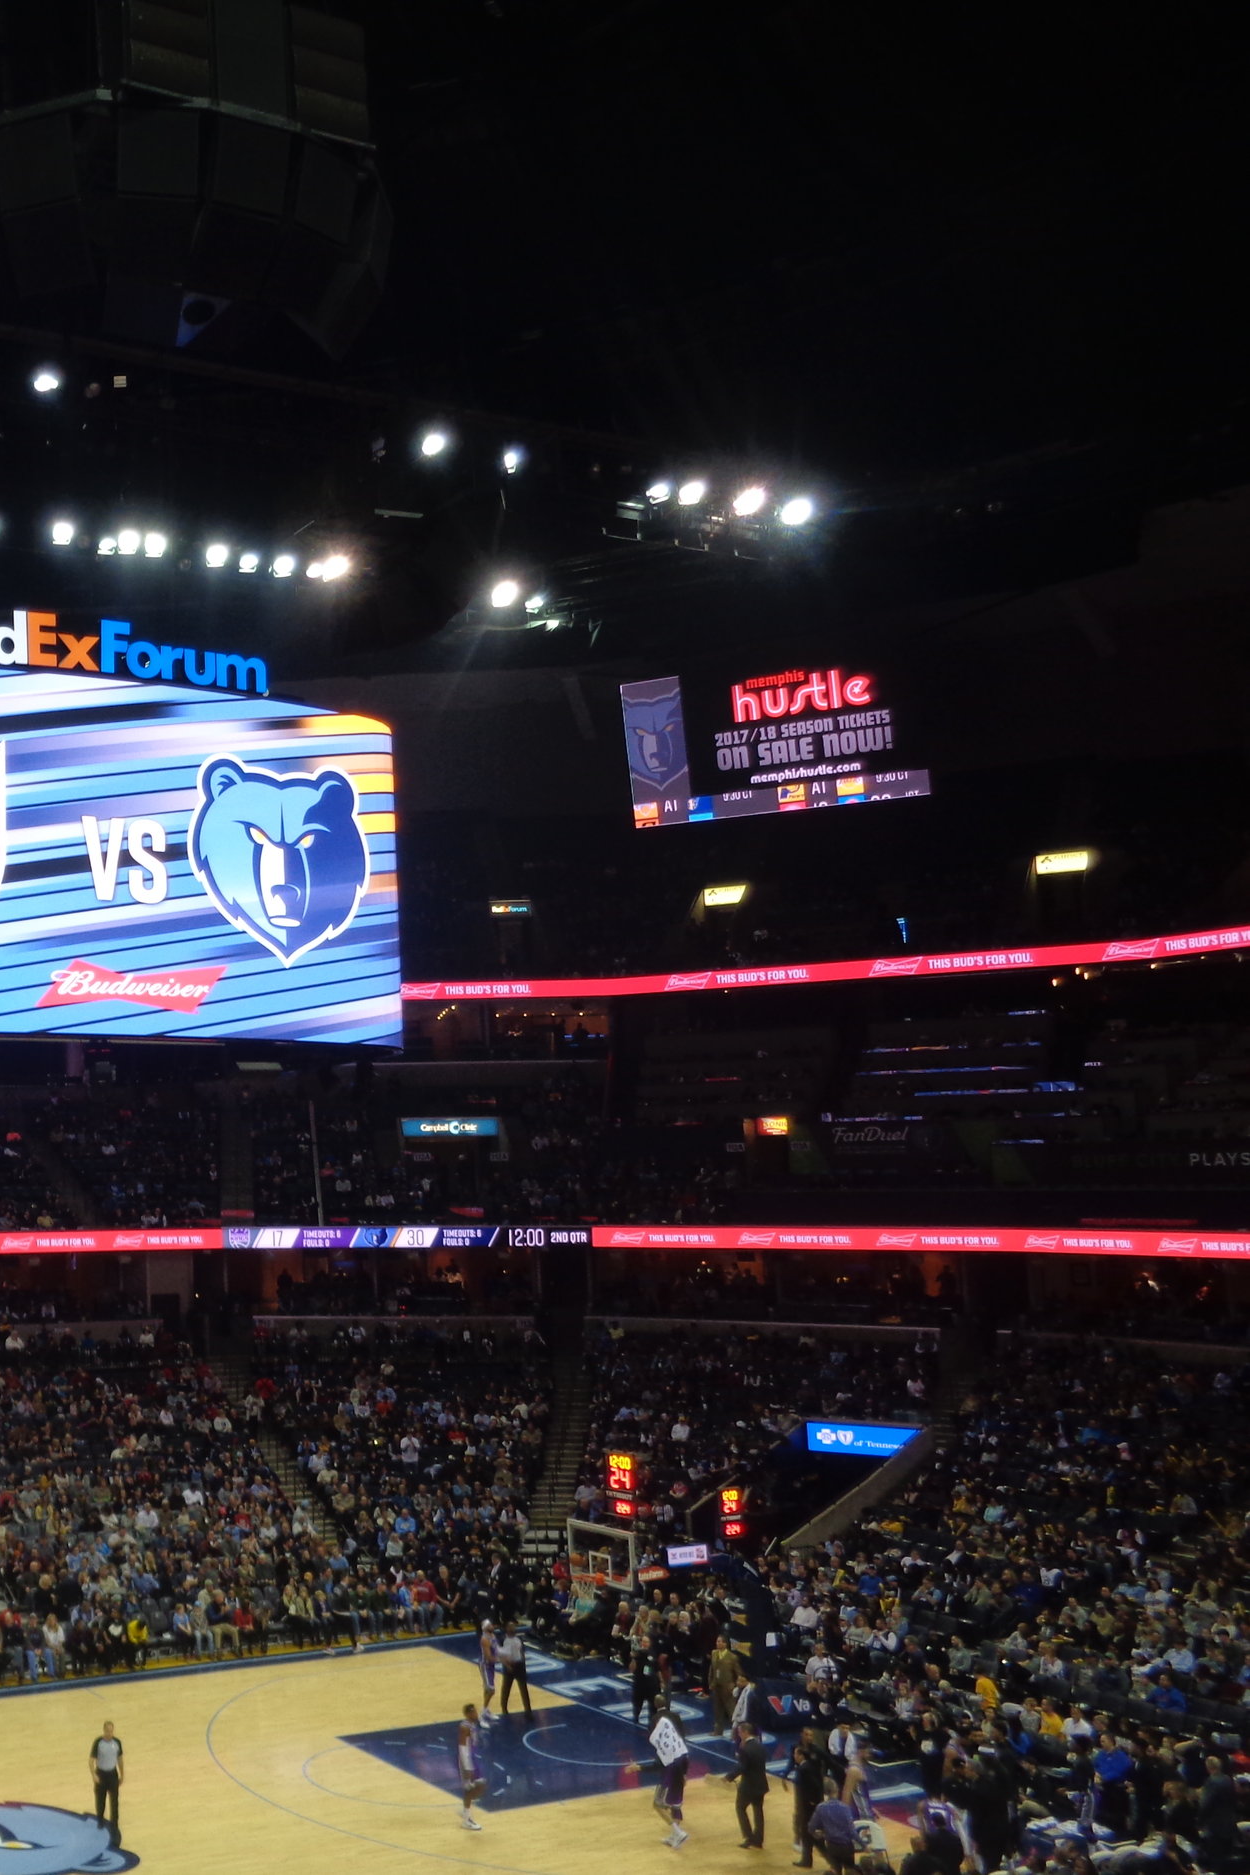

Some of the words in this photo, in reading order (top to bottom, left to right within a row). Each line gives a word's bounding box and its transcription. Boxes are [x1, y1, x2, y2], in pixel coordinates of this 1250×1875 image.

[745, 670, 805, 689] memphis
[731, 670, 872, 723] hustle
[715, 726, 775, 747] 2017/18
[781, 717, 833, 738] SEASON
[837, 709, 890, 729] TICKETS
[717, 748, 749, 771] ON
[758, 738, 814, 766] SALE
[823, 726, 894, 758] NOW!
[750, 761, 861, 784] memphishustle.com
[81, 815, 168, 904] VS
[1165, 941, 1184, 951] THIS
[1185, 937, 1217, 949] BUD'S
[1220, 934, 1240, 946] FOR
[928, 959, 950, 969] THIS
[953, 957, 983, 968] BUD'S
[986, 955, 1006, 965] FOR
[1008, 953, 1033, 963] YOU.
[51, 969, 210, 997] Budweiser
[716, 974, 736, 984] THIS
[738, 972, 765, 982] BUD'S
[769, 970, 785, 980] FOR
[788, 969, 809, 979] YOU.
[445, 985, 464, 995] THIS
[465, 984, 491, 995] BUD'S
[493, 984, 510, 994] FOR
[511, 984, 531, 994] YOU.
[832, 1126, 909, 1144] FanDuel
[1189, 1152, 1250, 1167] PLAYS
[303, 1230, 336, 1239] TIMEOUTS:
[407, 1229, 424, 1247] 30
[443, 1229, 476, 1238] TIMEOUTS:
[509, 1229, 545, 1247] 12:00
[551, 1232, 568, 1244] 2ND
[570, 1232, 587, 1244] QTR
[303, 1239, 324, 1248] FOULS:
[443, 1238, 464, 1247] FOULS:
[609, 1455, 631, 1470] 12:00
[610, 1467, 631, 1489] 24
[723, 1500, 737, 1513] 24
